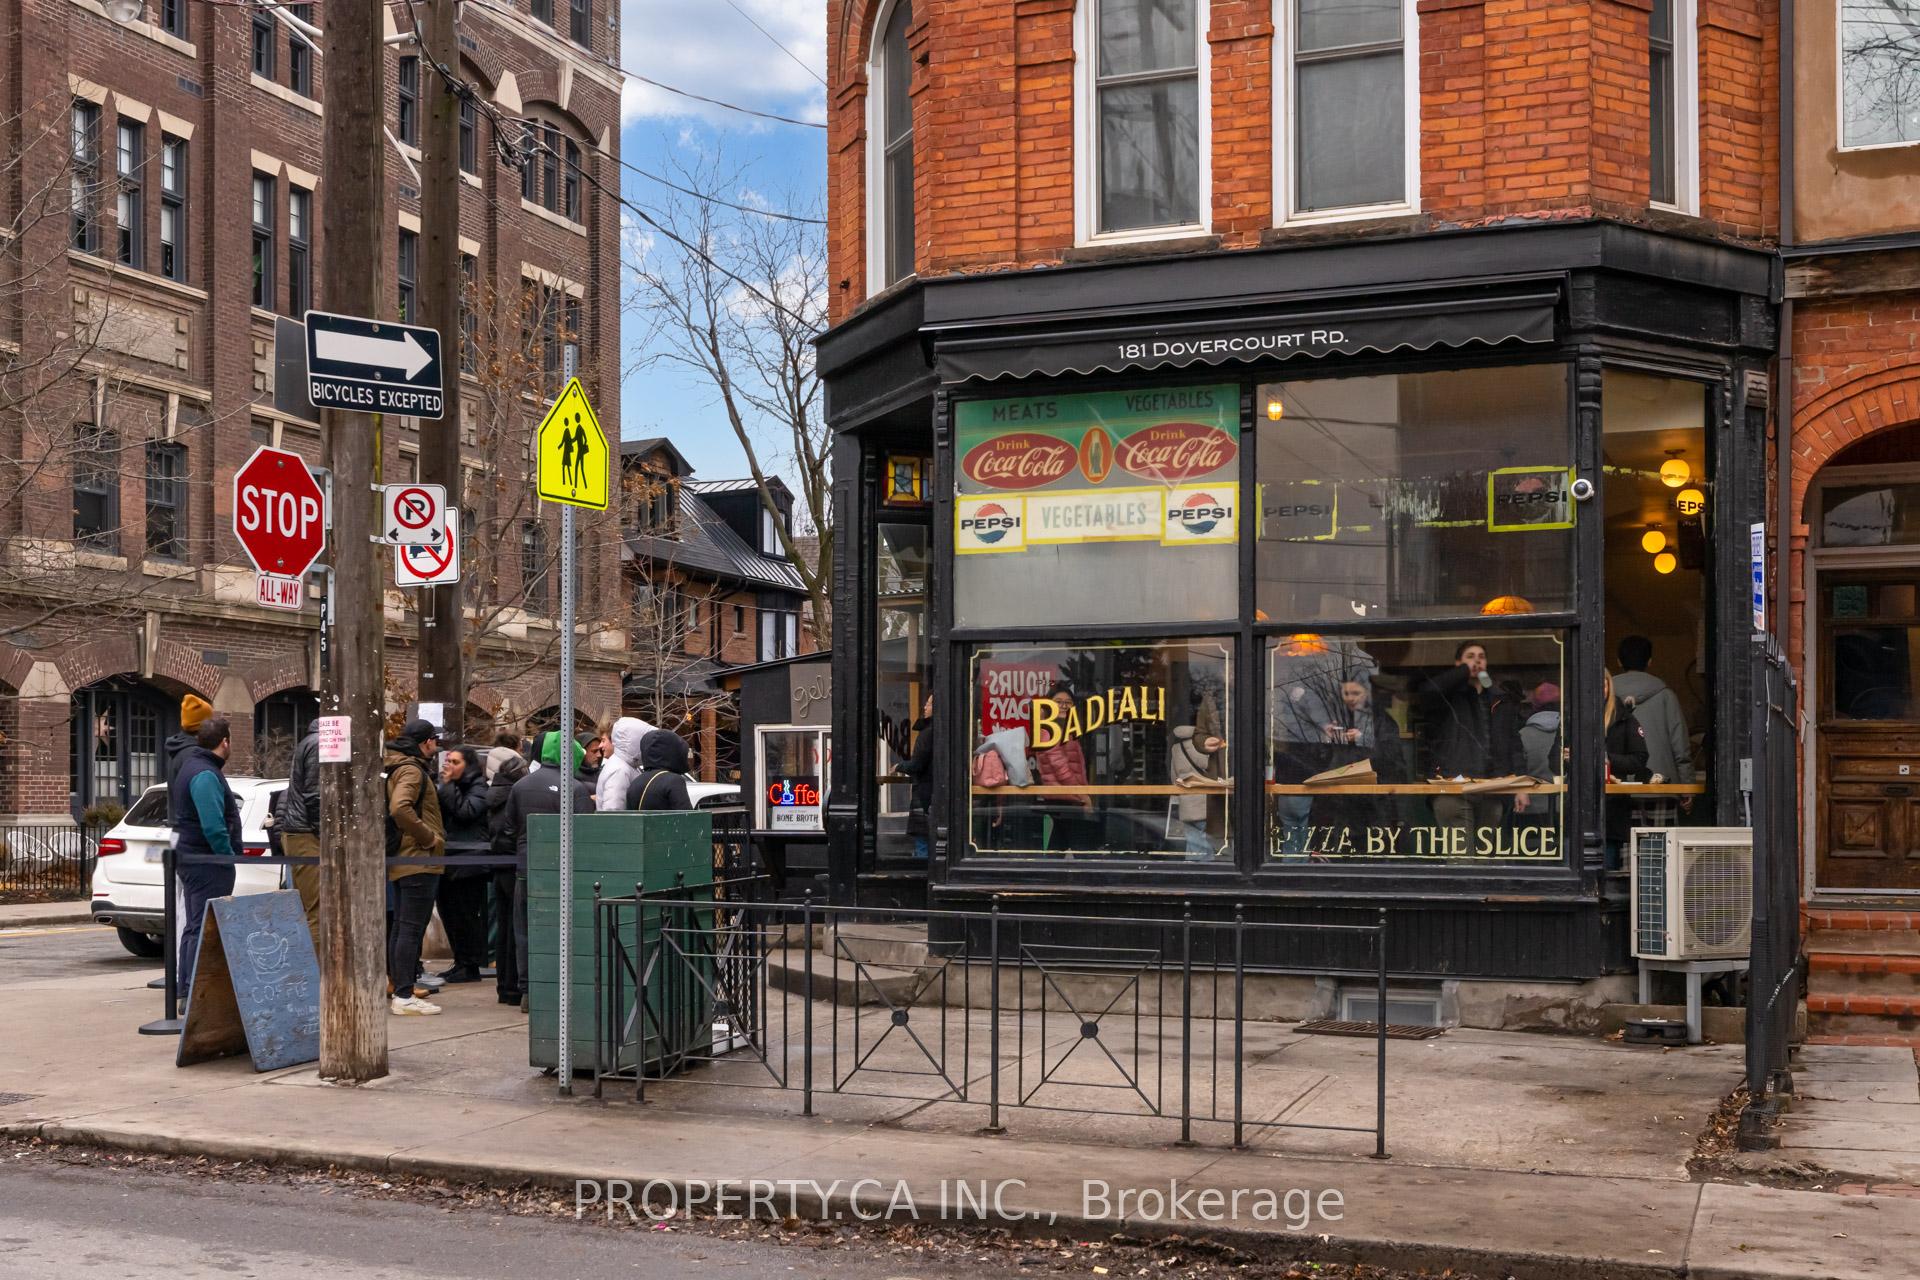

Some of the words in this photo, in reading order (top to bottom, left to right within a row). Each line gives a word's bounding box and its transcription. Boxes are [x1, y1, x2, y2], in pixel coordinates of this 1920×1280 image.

[1118, 343, 1147, 360] 181
[1153, 334, 1306, 357] DOVERCOURT
[1311, 330, 1349, 344] RD.
[312, 382, 374, 405] BICYCLES
[380, 390, 441, 412] EXCEPTED
[1126, 391, 1214, 412] VEGETABLES
[992, 402, 1058, 422] MEATS
[996, 439, 1031, 451] Drink
[1150, 429, 1187, 441] Drink
[974, 445, 1067, 481] Coca-Cola
[1125, 436, 1227, 472] Coca-Cola
[241, 484, 319, 540] STOP
[961, 516, 1021, 531] PEPSI
[1042, 502, 1147, 529] VEGETABLES
[1168, 506, 1232, 521] PEPSI
[1264, 504, 1330, 517] PEPSI
[259, 578, 299, 606] ALL-WAY
[1031, 685, 1166, 750] BADIALI
[1271, 826, 1356, 853] PZZA
[1367, 827, 1401, 854] BY
[1410, 826, 1467, 855] THE
[1475, 826, 1558, 856] SLICE
